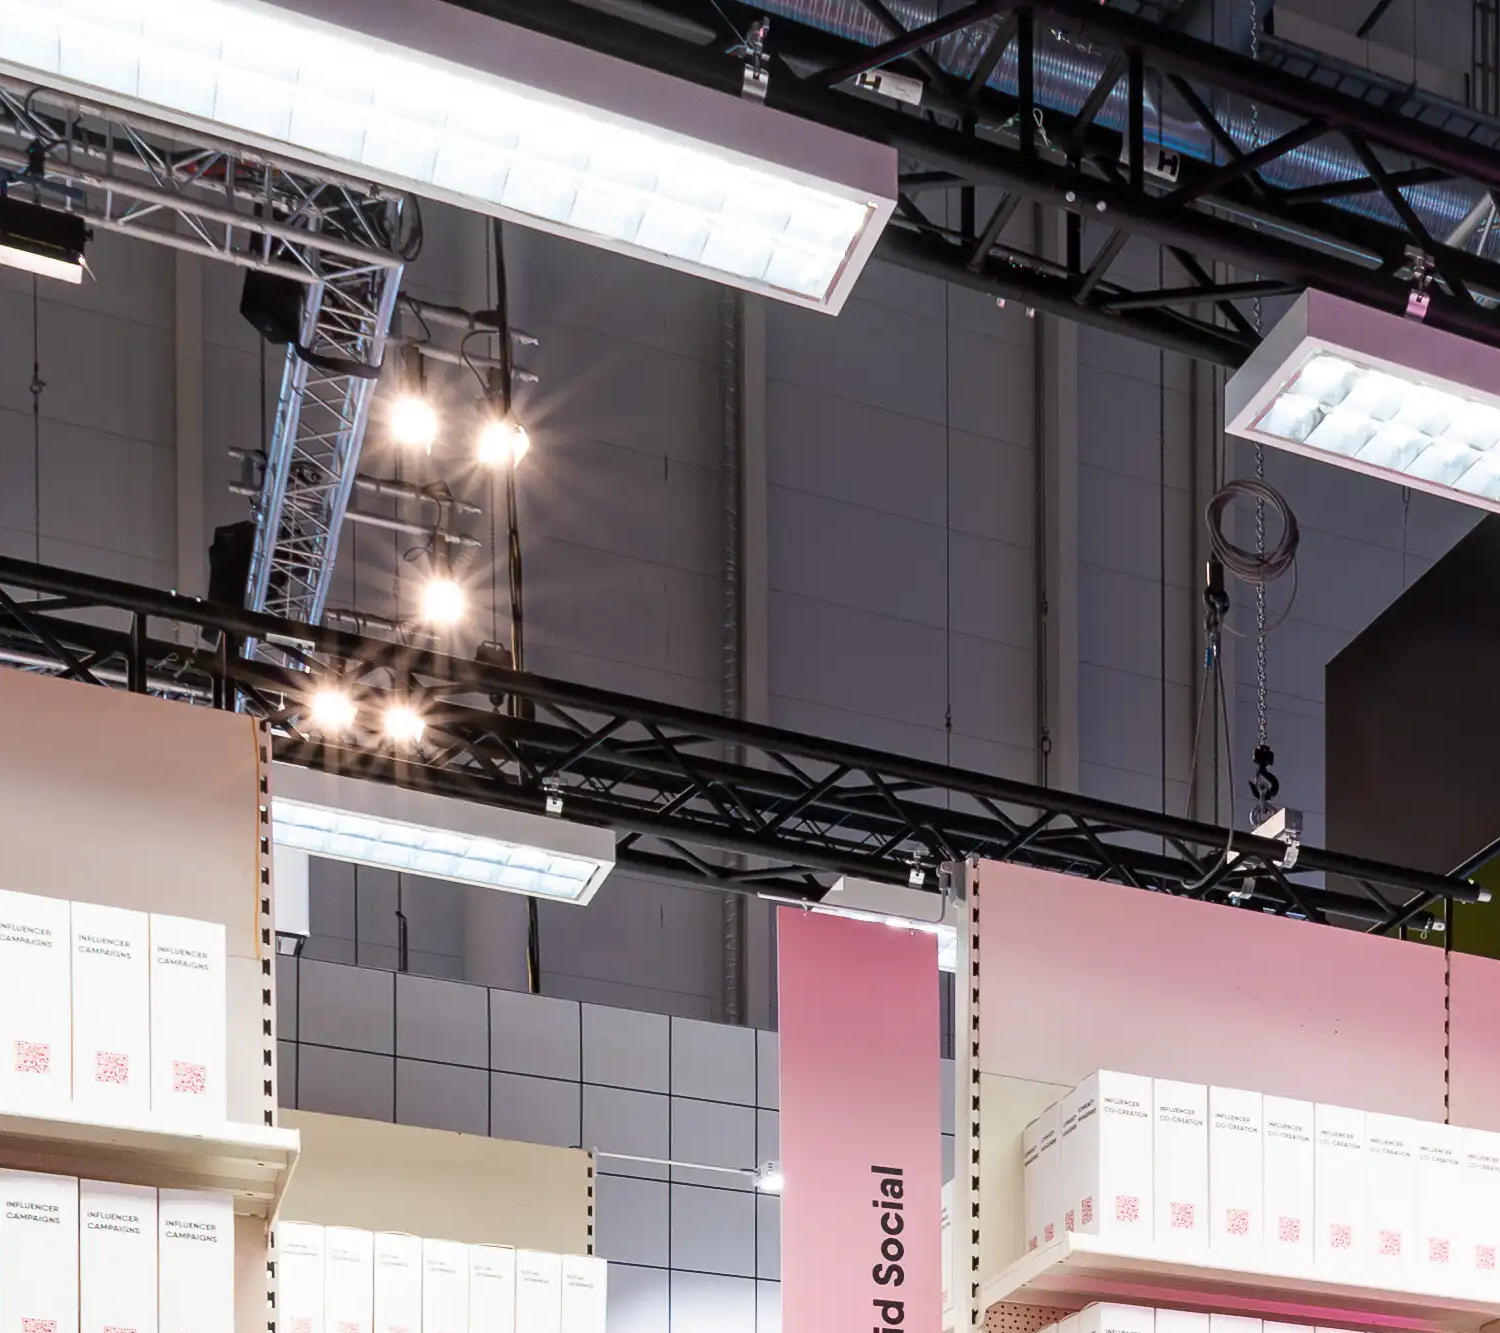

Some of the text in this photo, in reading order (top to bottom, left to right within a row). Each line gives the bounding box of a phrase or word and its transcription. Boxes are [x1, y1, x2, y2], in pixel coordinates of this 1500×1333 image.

[1104, 1097, 1140, 1108] INFLUENCER
[1104, 1106, 1148, 1118] CO-CREATION
[6, 1201, 59, 1212] INFLUENCER
[6, 1212, 60, 1224] CAMPAIGNS
[871, 1165, 905, 1288] Social
